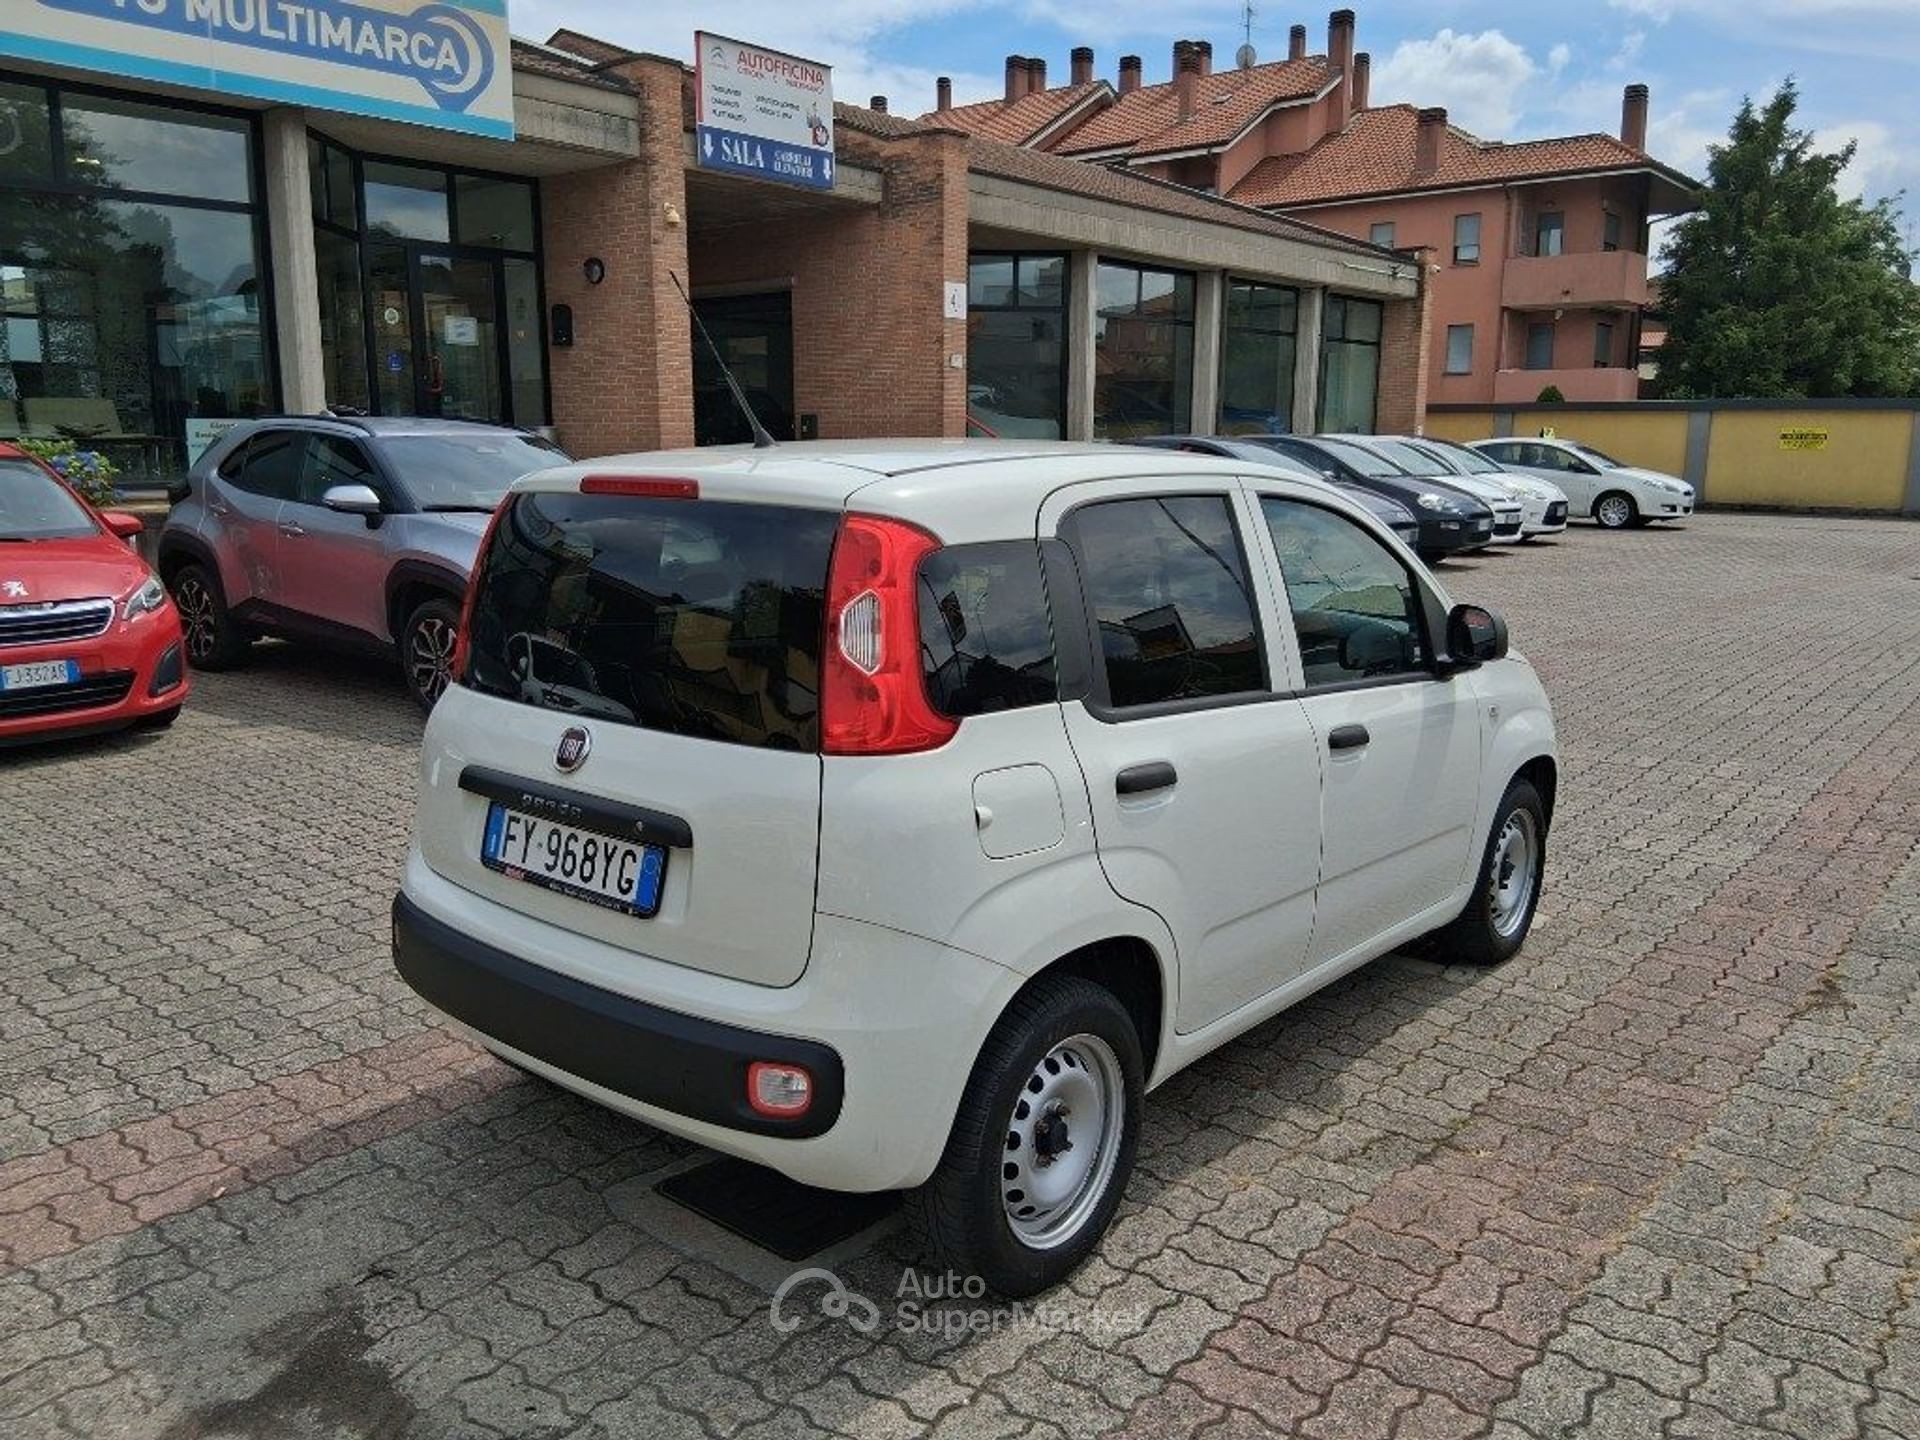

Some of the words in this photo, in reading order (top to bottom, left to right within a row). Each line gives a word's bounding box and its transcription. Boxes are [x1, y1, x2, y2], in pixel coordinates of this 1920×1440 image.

[185, 0, 462, 76] MULTIMARCA
[737, 50, 825, 85] AUTOFFICINA
[721, 137, 765, 168] SALA
